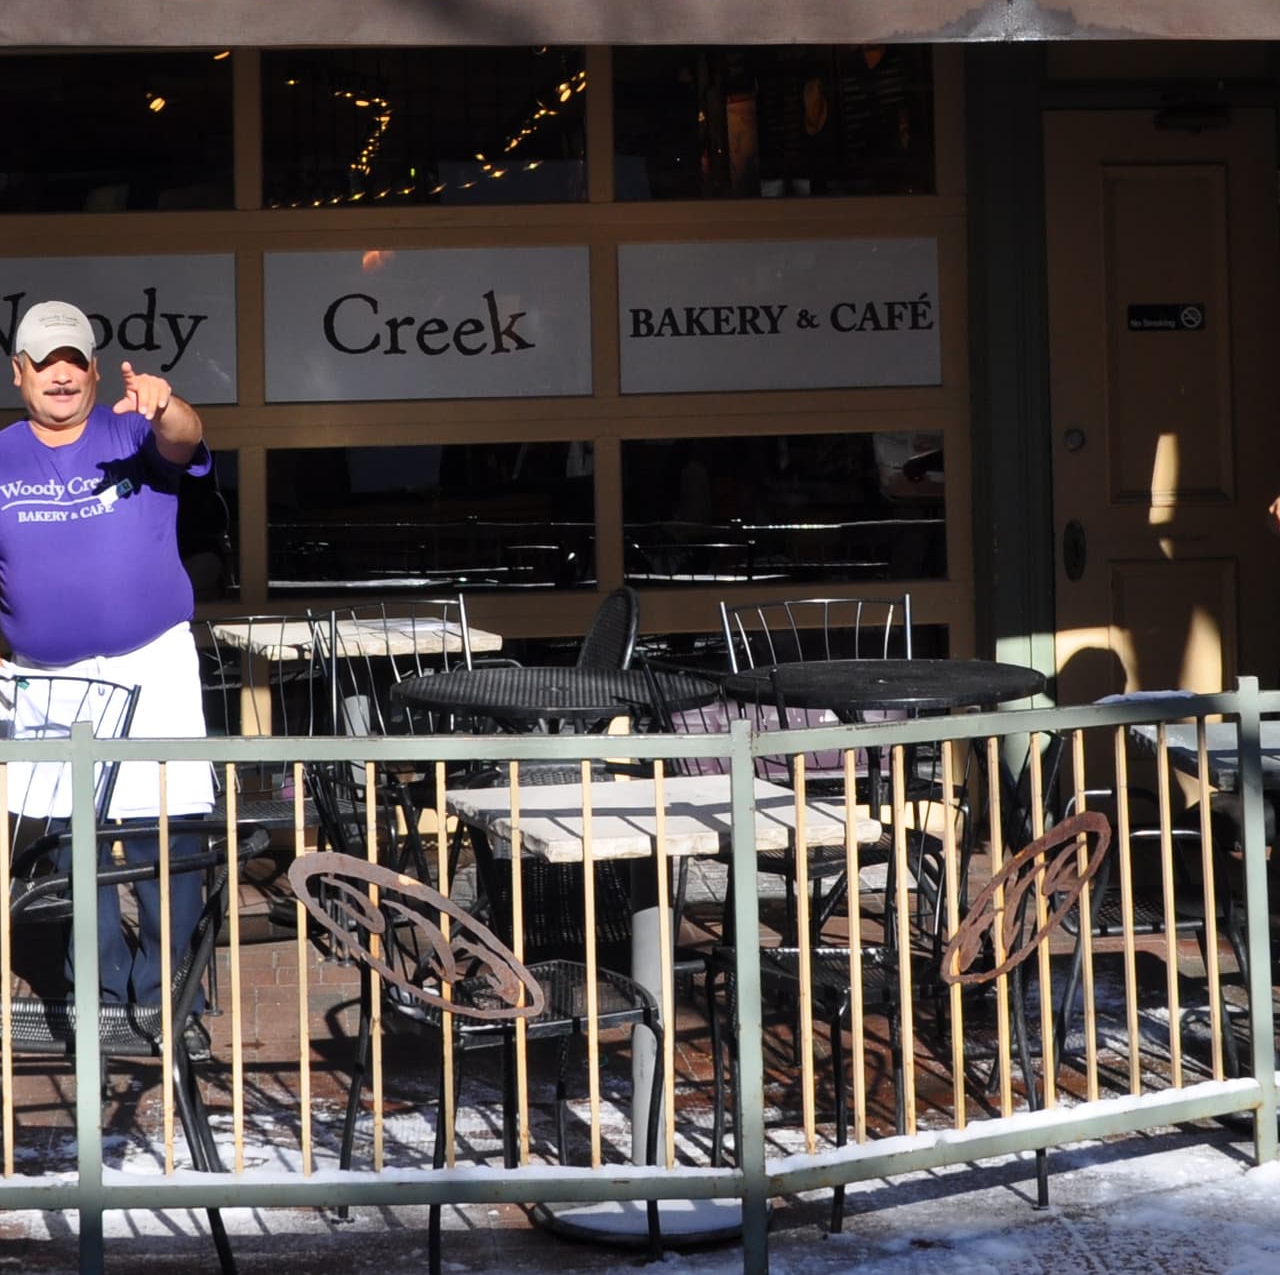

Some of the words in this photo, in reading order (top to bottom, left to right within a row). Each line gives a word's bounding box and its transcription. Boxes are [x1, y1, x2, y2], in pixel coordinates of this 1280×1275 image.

[322, 290, 535, 357] Creek
[628, 305, 787, 338] BAKERY
[796, 311, 818, 329] &
[830, 294, 934, 333] CAFÉ
[0, 478, 65, 501] Woody
[18, 510, 69, 523] BAKERY
